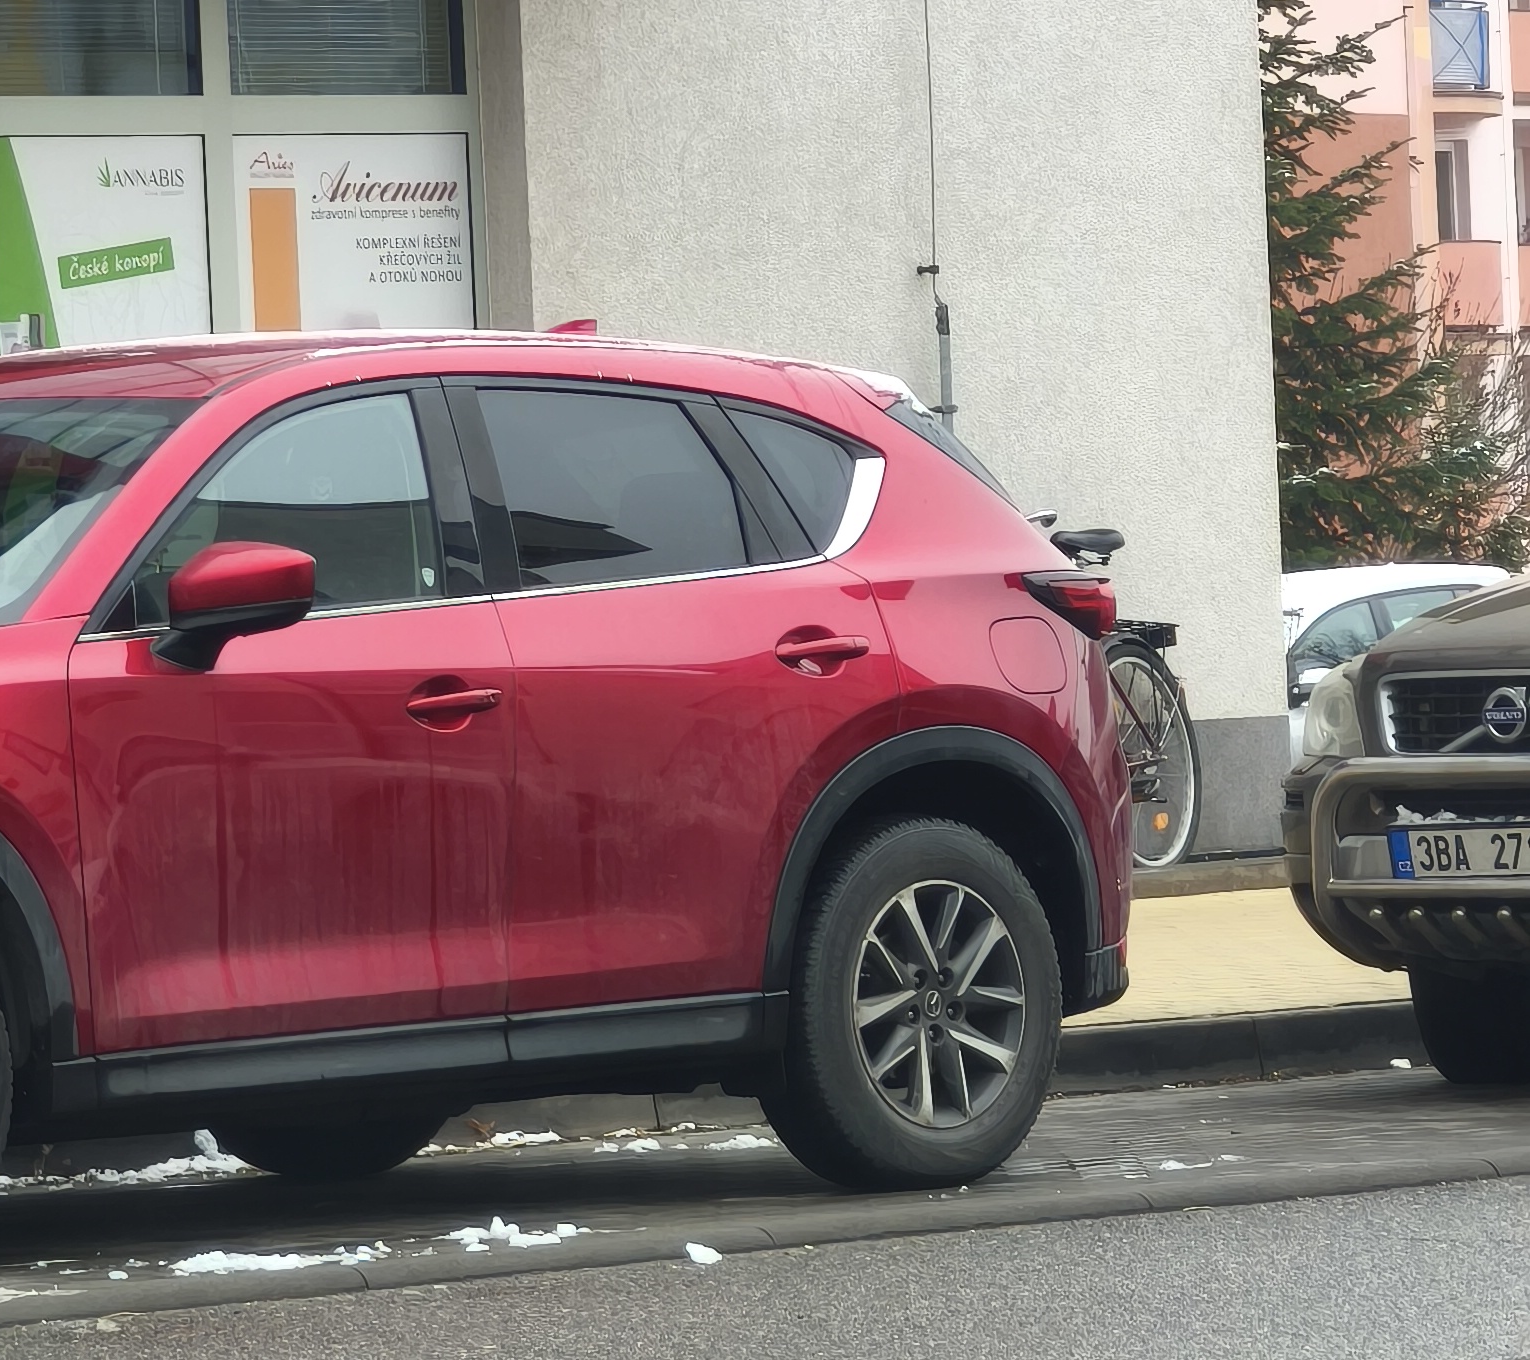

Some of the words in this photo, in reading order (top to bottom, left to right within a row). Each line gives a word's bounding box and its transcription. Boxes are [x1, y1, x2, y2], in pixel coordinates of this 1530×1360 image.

[112, 168, 185, 188] ANNABIS
[311, 160, 458, 203] Avicenum
[419, 204, 460, 221] benefity
[355, 233, 420, 249] KOMPLEXNÍ
[423, 230, 461, 249] ŘEŠENÍ
[69, 255, 109, 280] České
[115, 246, 164, 273] konopí
[378, 250, 444, 266] KŘEČOVÝCH
[446, 250, 462, 265] ŽIL
[369, 271, 377, 283] A
[379, 267, 417, 283] OTOKŮ
[420, 269, 462, 283] NOHOU
[1485, 711, 1523, 720] VOLVO
[1416, 834, 1472, 872] 3BA
[1490, 832, 1530, 871] 27
